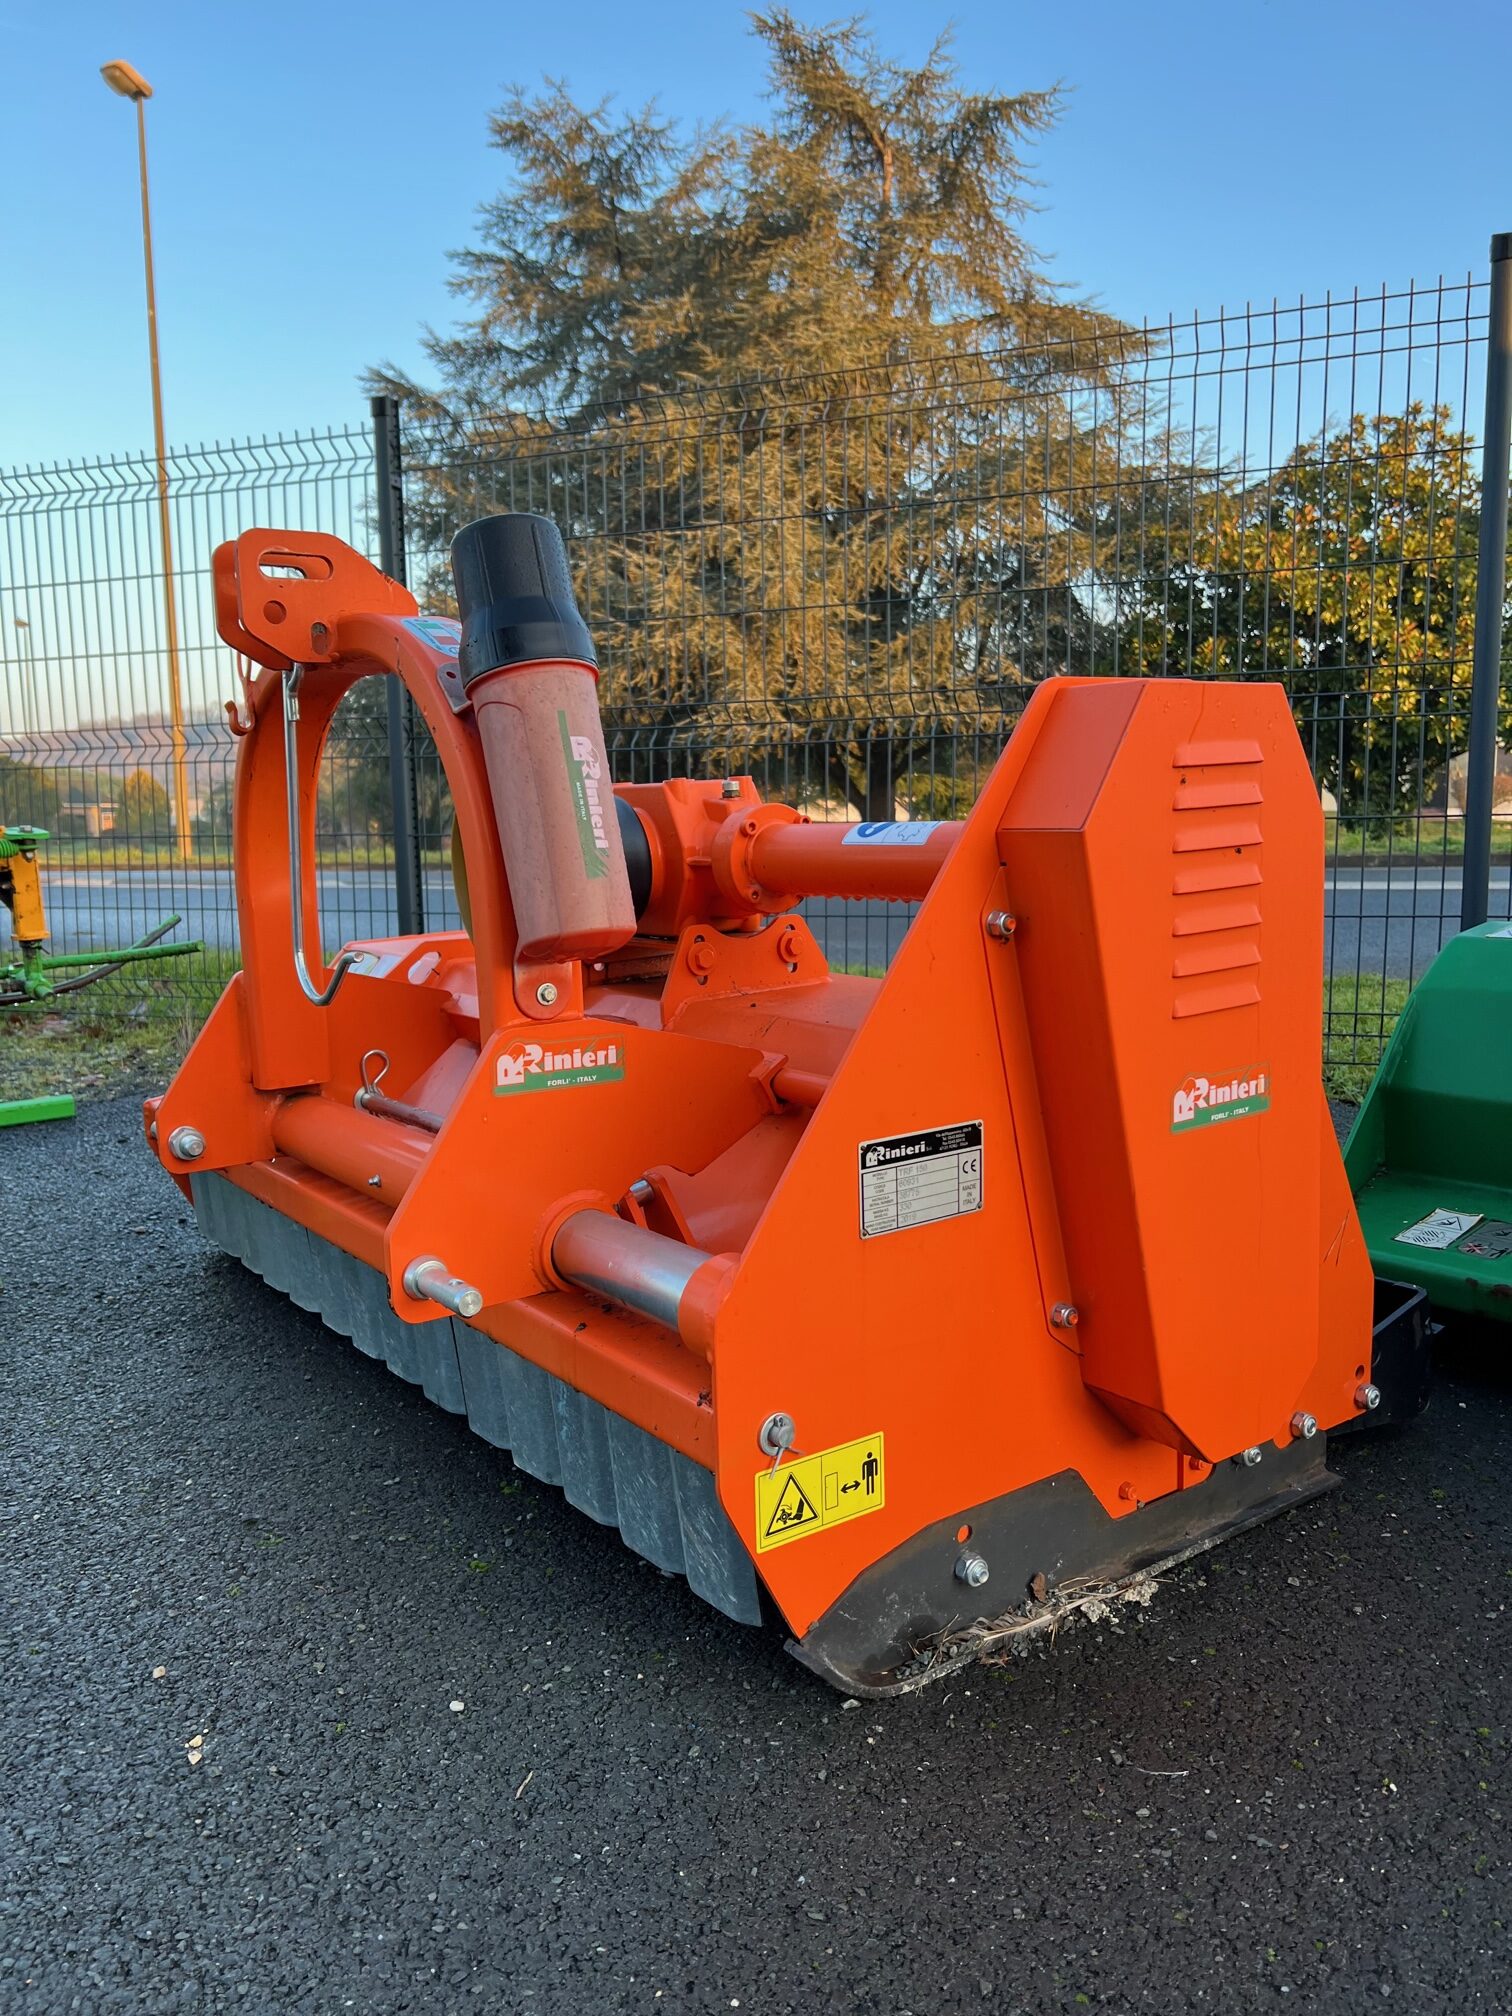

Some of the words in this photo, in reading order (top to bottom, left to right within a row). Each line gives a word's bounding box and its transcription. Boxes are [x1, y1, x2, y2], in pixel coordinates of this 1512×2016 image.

[581, 756, 609, 849] Rinieri
[517, 1043, 617, 1074] Rinieri
[577, 1075, 597, 1083] ITALY
[1188, 1074, 1265, 1108] Rinieri
[1233, 1106, 1249, 1116] ITALY
[874, 1141, 926, 1161] Rinieri
[962, 1183, 977, 1192] MADE
[962, 1198, 976, 1206] ITALY
